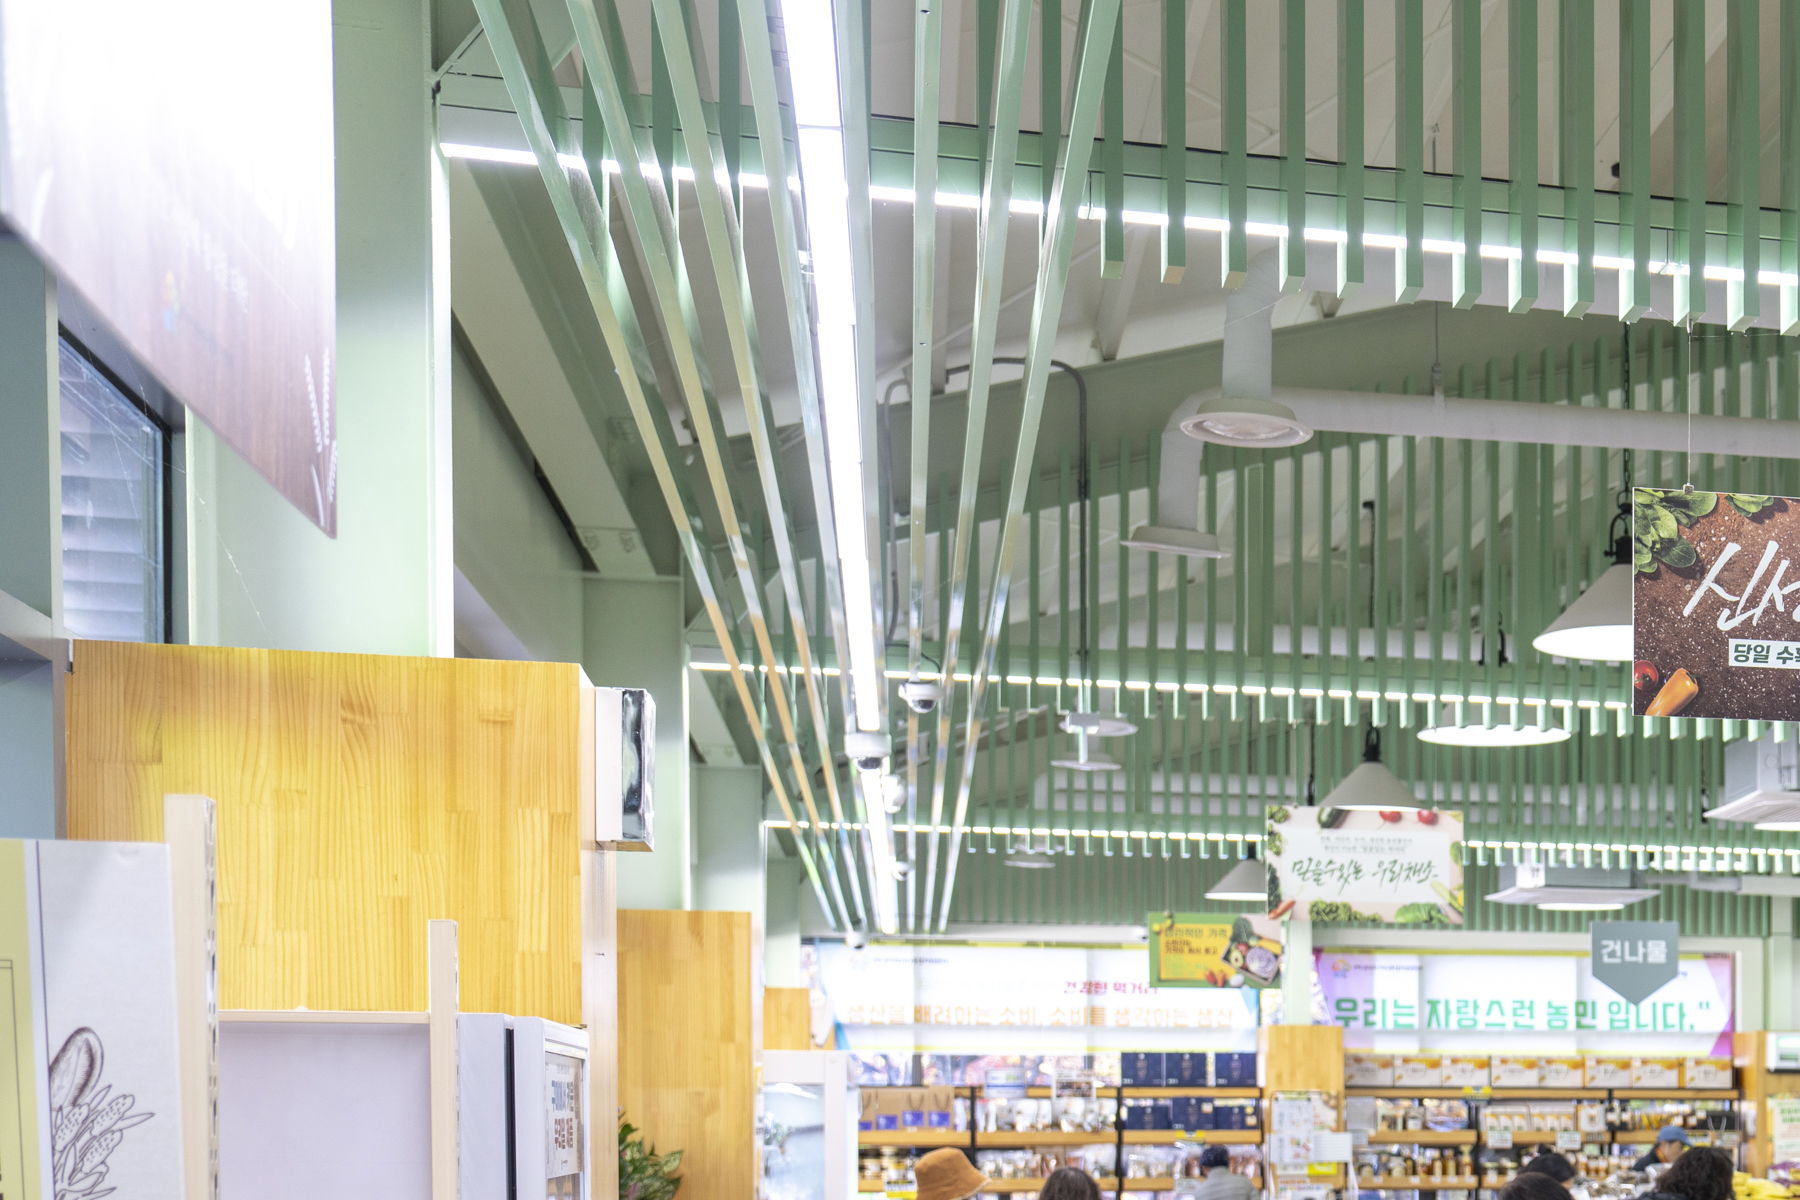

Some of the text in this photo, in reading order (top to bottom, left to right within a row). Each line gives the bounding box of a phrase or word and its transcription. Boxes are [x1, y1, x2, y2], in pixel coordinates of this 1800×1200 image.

[1733, 643, 1771, 664] 당일
[1209, 928, 1227, 938] 가격
[1601, 939, 1667, 965] 건나물
[914, 1005, 991, 1026] 배려하는
[1050, 1006, 1105, 1026] 소비를
[1114, 1007, 1188, 1027] 생각하는
[1197, 1008, 1232, 1027] 생산
[1426, 999, 1536, 1029] 자랑스런
[1546, 1001, 1598, 1030] 농민
